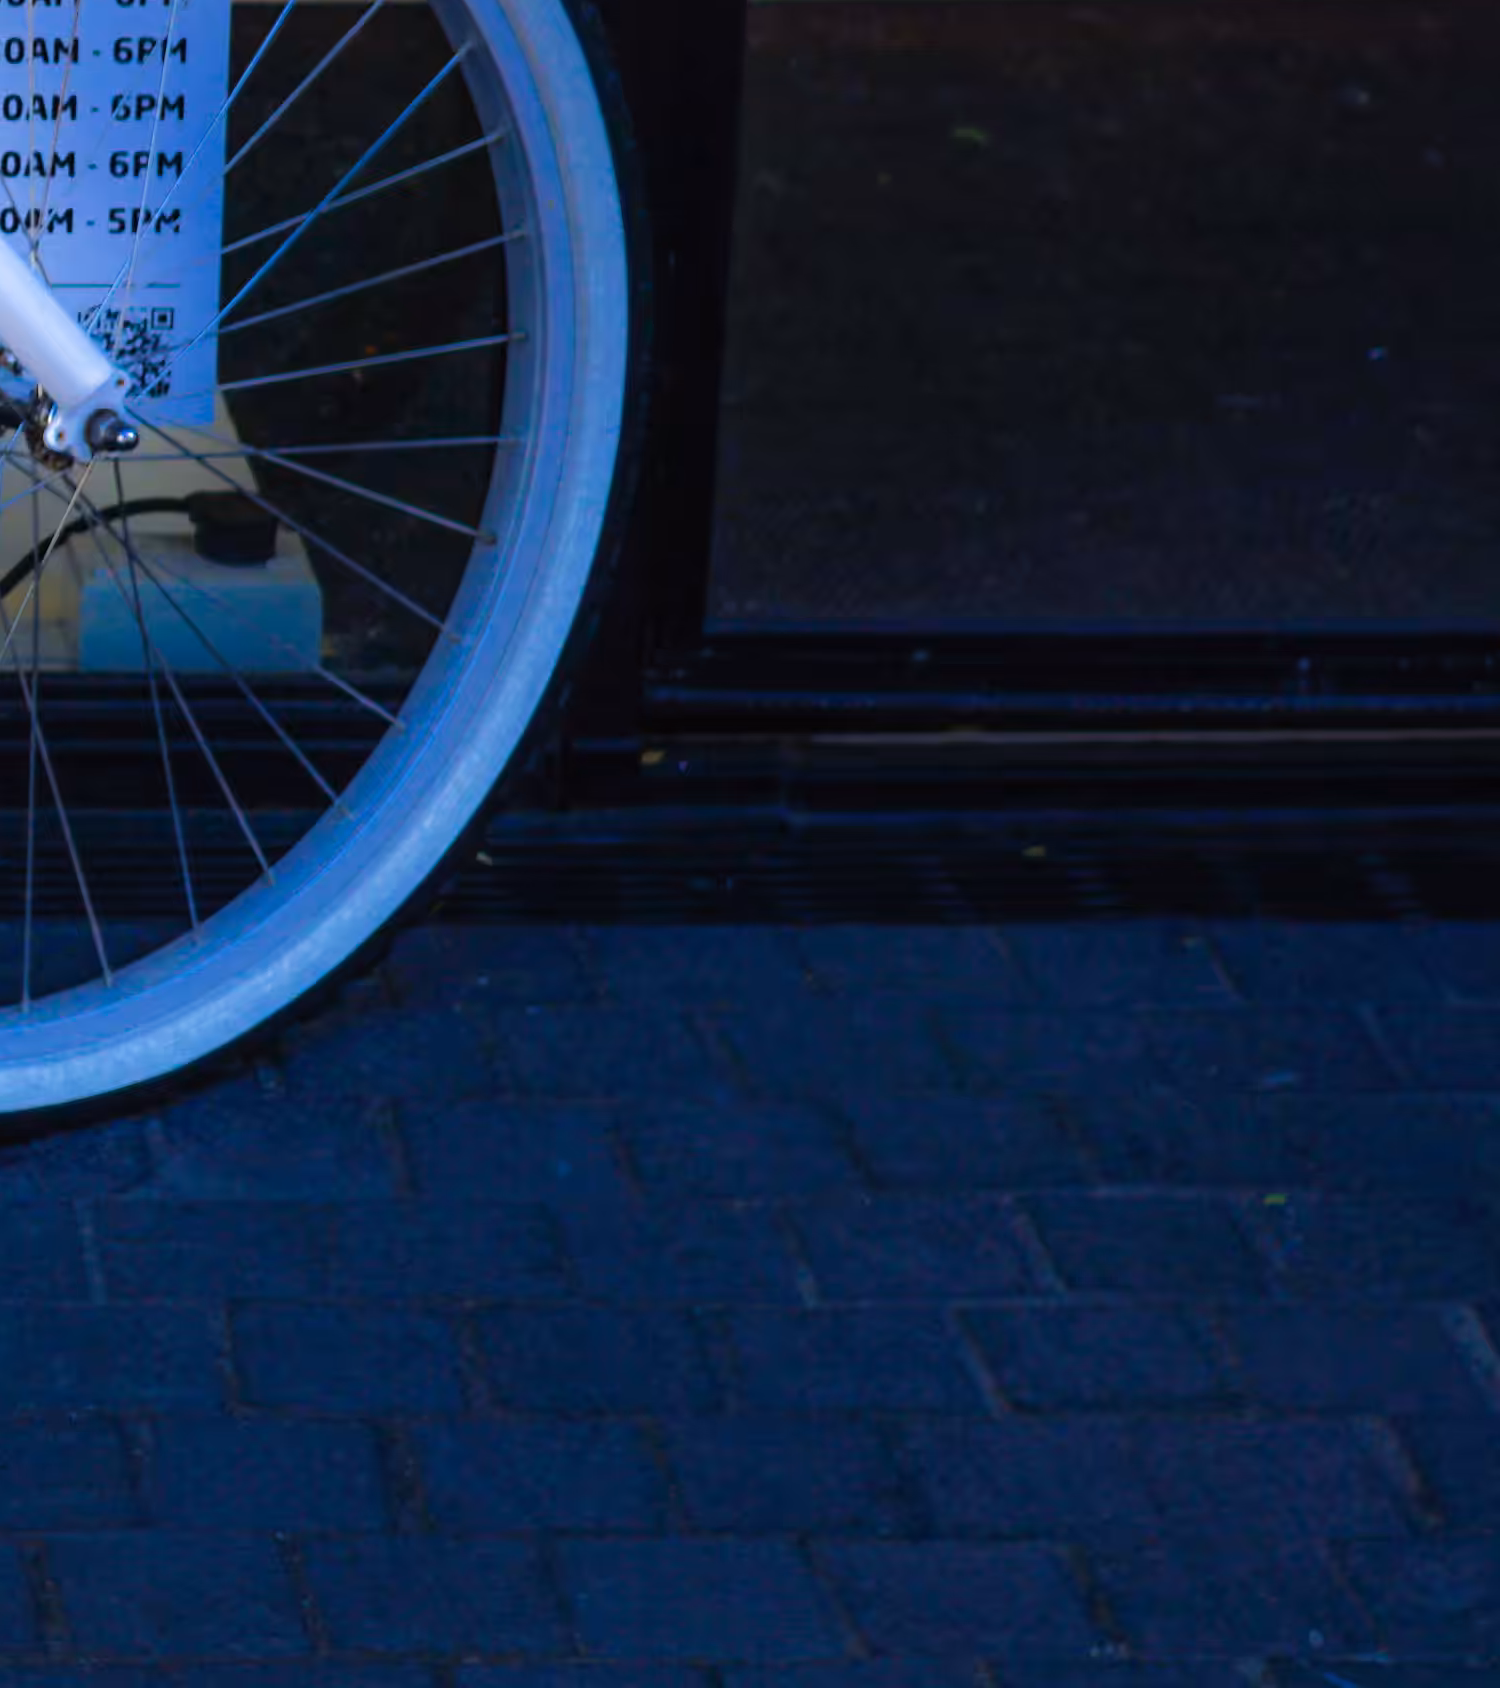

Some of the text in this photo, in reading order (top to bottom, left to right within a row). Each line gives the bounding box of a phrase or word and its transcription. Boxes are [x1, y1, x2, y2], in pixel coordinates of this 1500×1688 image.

[112, 36, 187, 65] 6PM
[111, 93, 185, 121] 6PM
[108, 150, 184, 179] 6PM
[108, 207, 182, 234] 5PM
